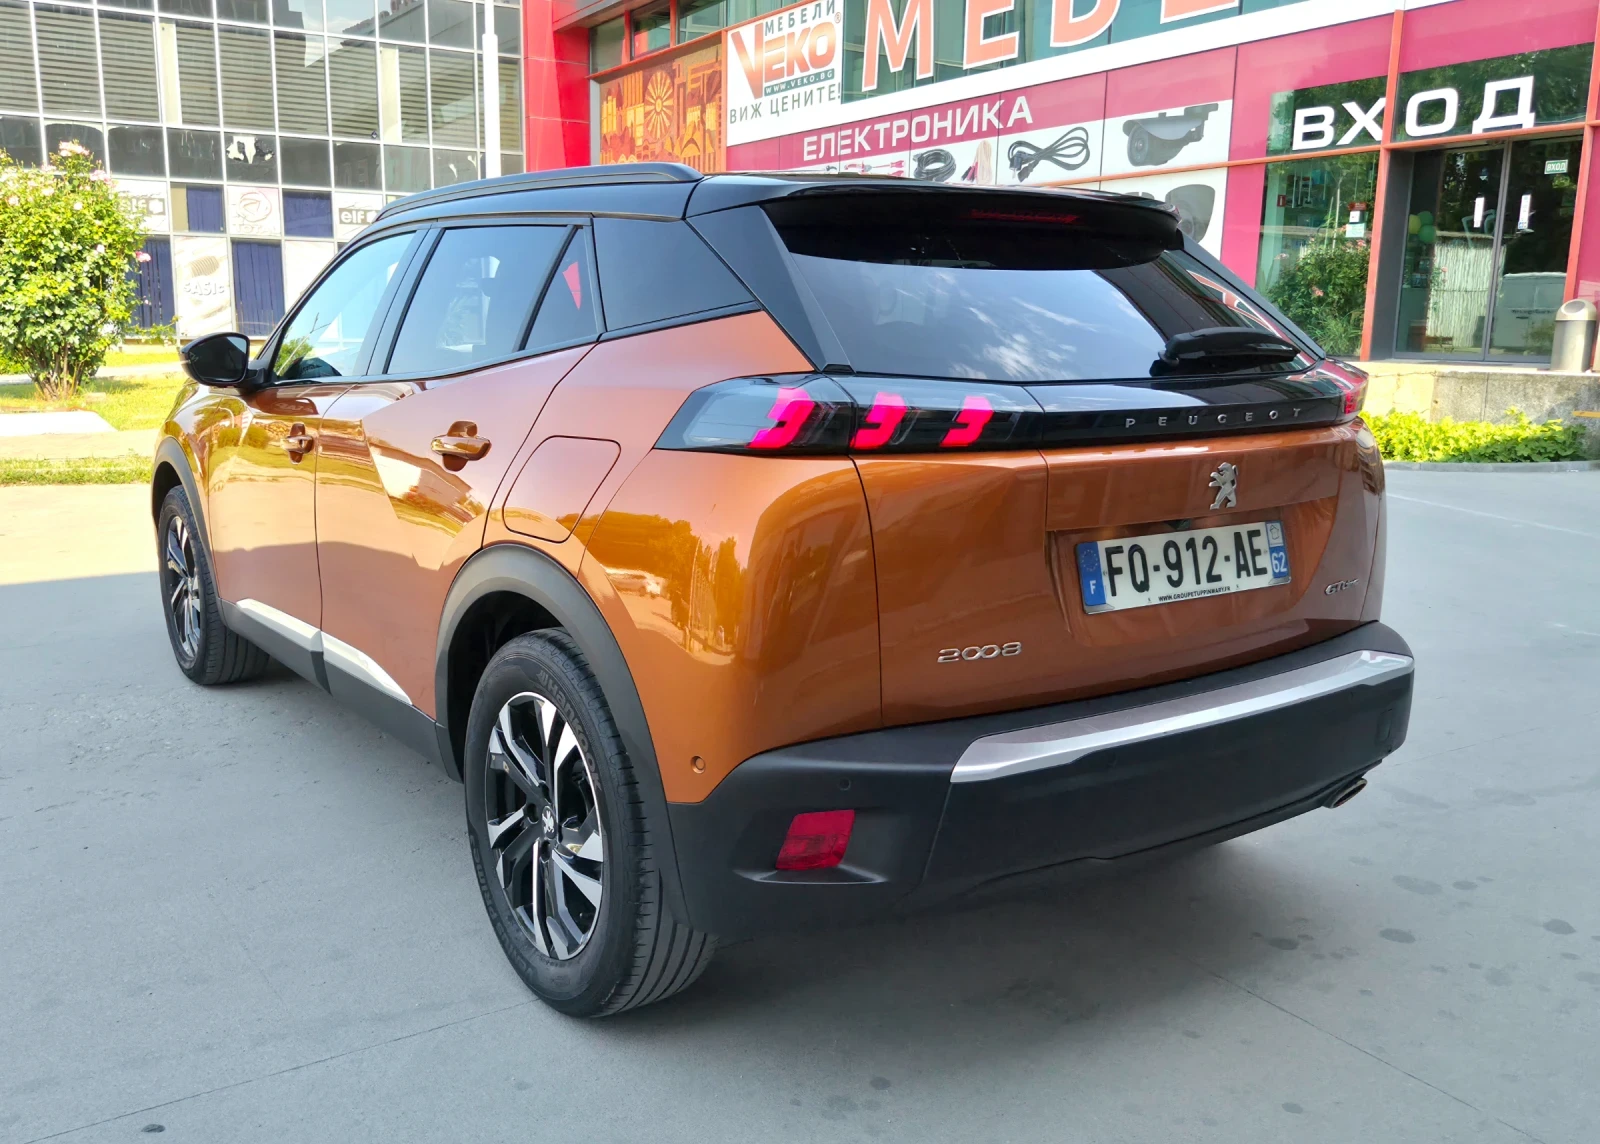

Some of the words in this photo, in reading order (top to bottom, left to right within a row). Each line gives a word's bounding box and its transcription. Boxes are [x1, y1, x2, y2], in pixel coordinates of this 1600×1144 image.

[765, 0, 835, 36] МЕБЕЛИ
[731, 21, 837, 100] VEKO
[765, 70, 833, 95] WWW.VEKO.BG
[729, 102, 762, 124] ВИЖ
[770, 82, 841, 117] ЦЕНИТЕ!
[1292, 75, 1535, 151] ВХОД
[803, 95, 1033, 161] ЕЛЕКТРОНИКА
[1546, 162, 1566, 172] ВХОД
[340, 210, 366, 224] elf
[1125, 407, 1301, 429] PEUGEOT
[1105, 529, 1268, 597] FQ-912-AE
[1271, 551, 1288, 574] 62
[1089, 579, 1097, 595] F
[937, 641, 1022, 663] 2008
[547, 677, 602, 791] Hankook
